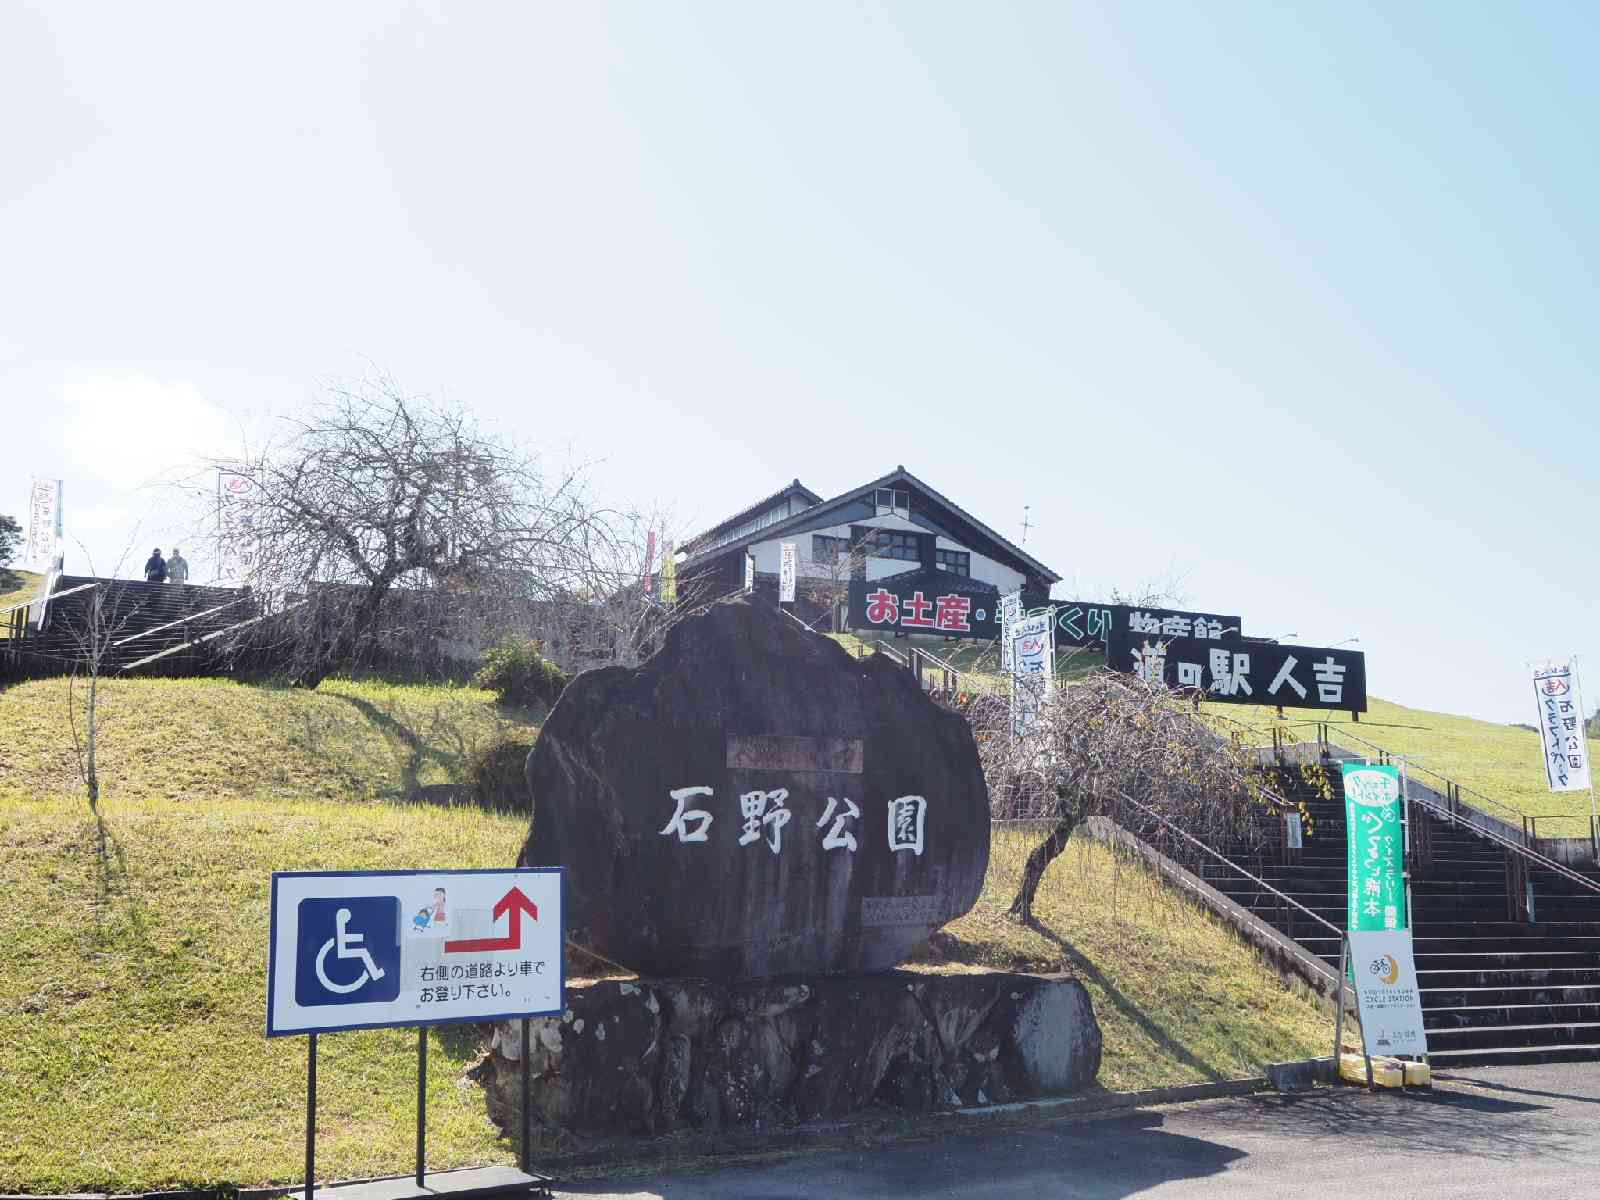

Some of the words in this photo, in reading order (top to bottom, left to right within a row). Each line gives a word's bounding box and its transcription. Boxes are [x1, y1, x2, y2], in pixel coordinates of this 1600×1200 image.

[1129, 611, 1223, 639] 物産館
[658, 786, 928, 856] 石野公園
[420, 960, 545, 982] 右側の道路より車で
[420, 983, 512, 1003] お登り下さい。
